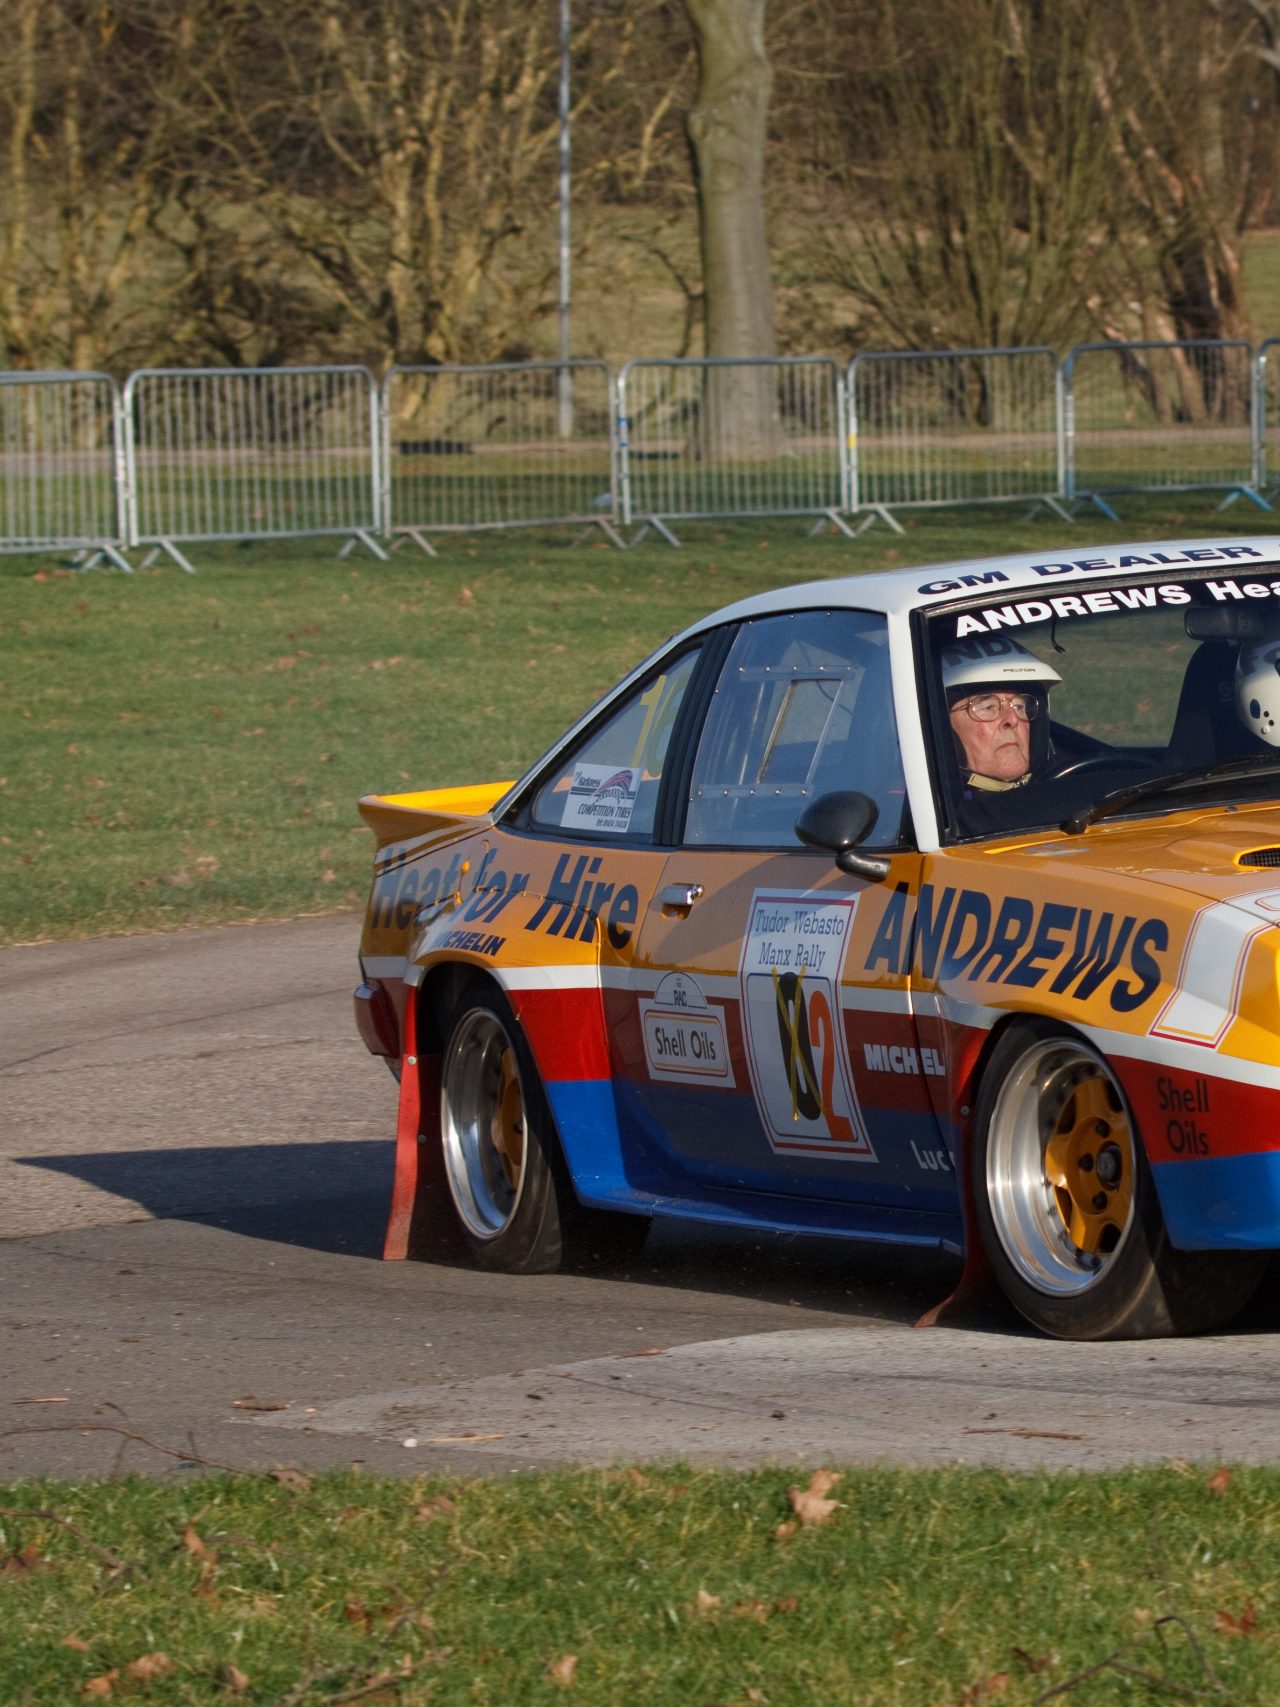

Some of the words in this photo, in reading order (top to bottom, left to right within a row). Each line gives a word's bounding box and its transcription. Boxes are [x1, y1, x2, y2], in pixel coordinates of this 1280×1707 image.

[917, 570, 1010, 595] GM
[1030, 546, 1263, 577] DEALER
[956, 585, 1192, 638] ANDREWS
[446, 847, 531, 924] for
[523, 853, 639, 950] Hire
[755, 909, 789, 934] Tudor
[792, 910, 844, 937] Webasto
[758, 941, 792, 966] Manx
[794, 943, 826, 973] Rally
[863, 880, 1169, 1013] ANDREWS
[654, 1026, 687, 1057] Shell
[690, 1030, 716, 1061] Oils
[1156, 1076, 1209, 1113] Shell
[1166, 1119, 1209, 1155] Oils
